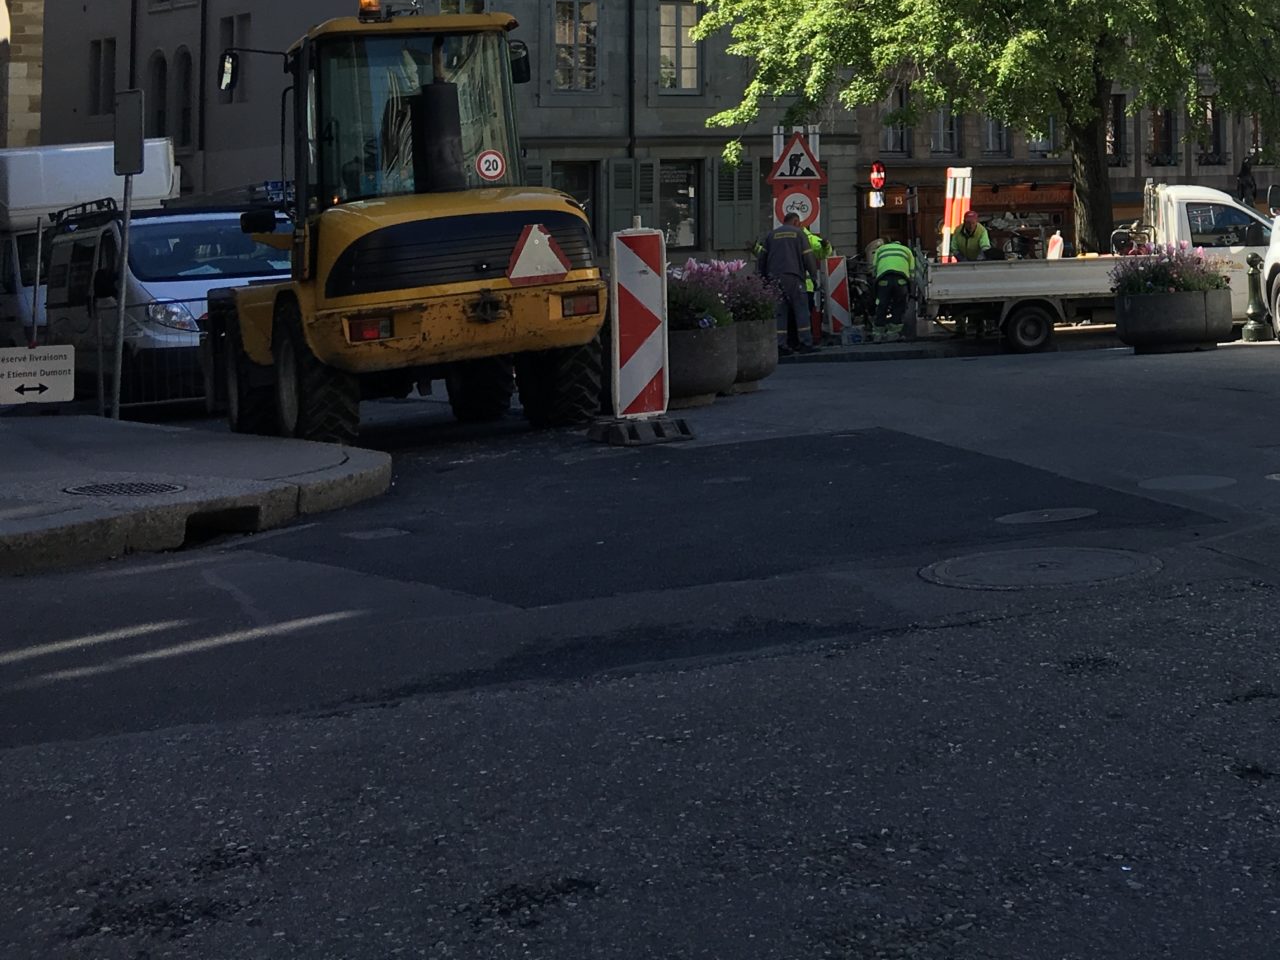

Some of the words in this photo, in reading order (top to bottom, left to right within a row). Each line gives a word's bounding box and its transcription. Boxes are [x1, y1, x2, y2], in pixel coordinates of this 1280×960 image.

[484, 159, 499, 172] 20
[895, 195, 903, 205] 13
[0, 354, 27, 364] éservé
[29, 353, 67, 362] livraisons
[7, 370, 37, 379] Etienne
[40, 368, 72, 377] Dumont
